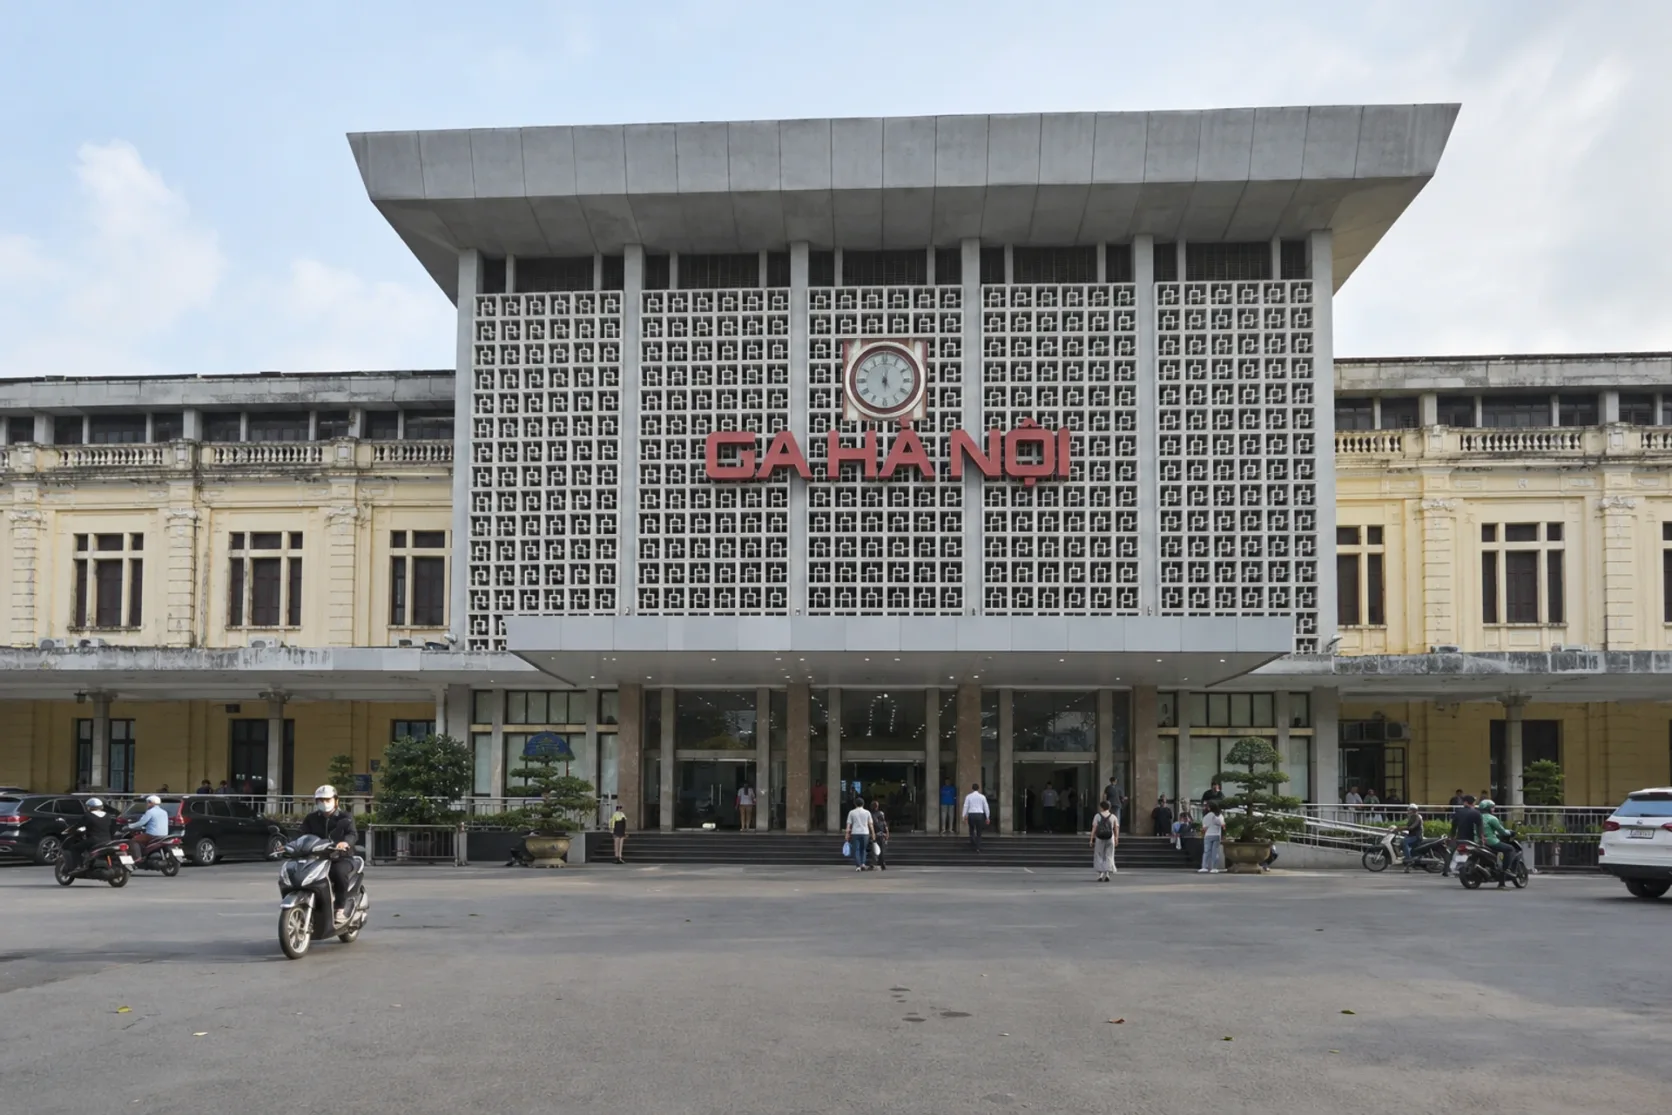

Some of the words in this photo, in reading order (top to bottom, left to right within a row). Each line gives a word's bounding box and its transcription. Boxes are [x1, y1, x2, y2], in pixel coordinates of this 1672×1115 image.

[705, 430, 814, 481] GA
[827, 417, 936, 482] HÀ
[950, 416, 1071, 487] NỘI
